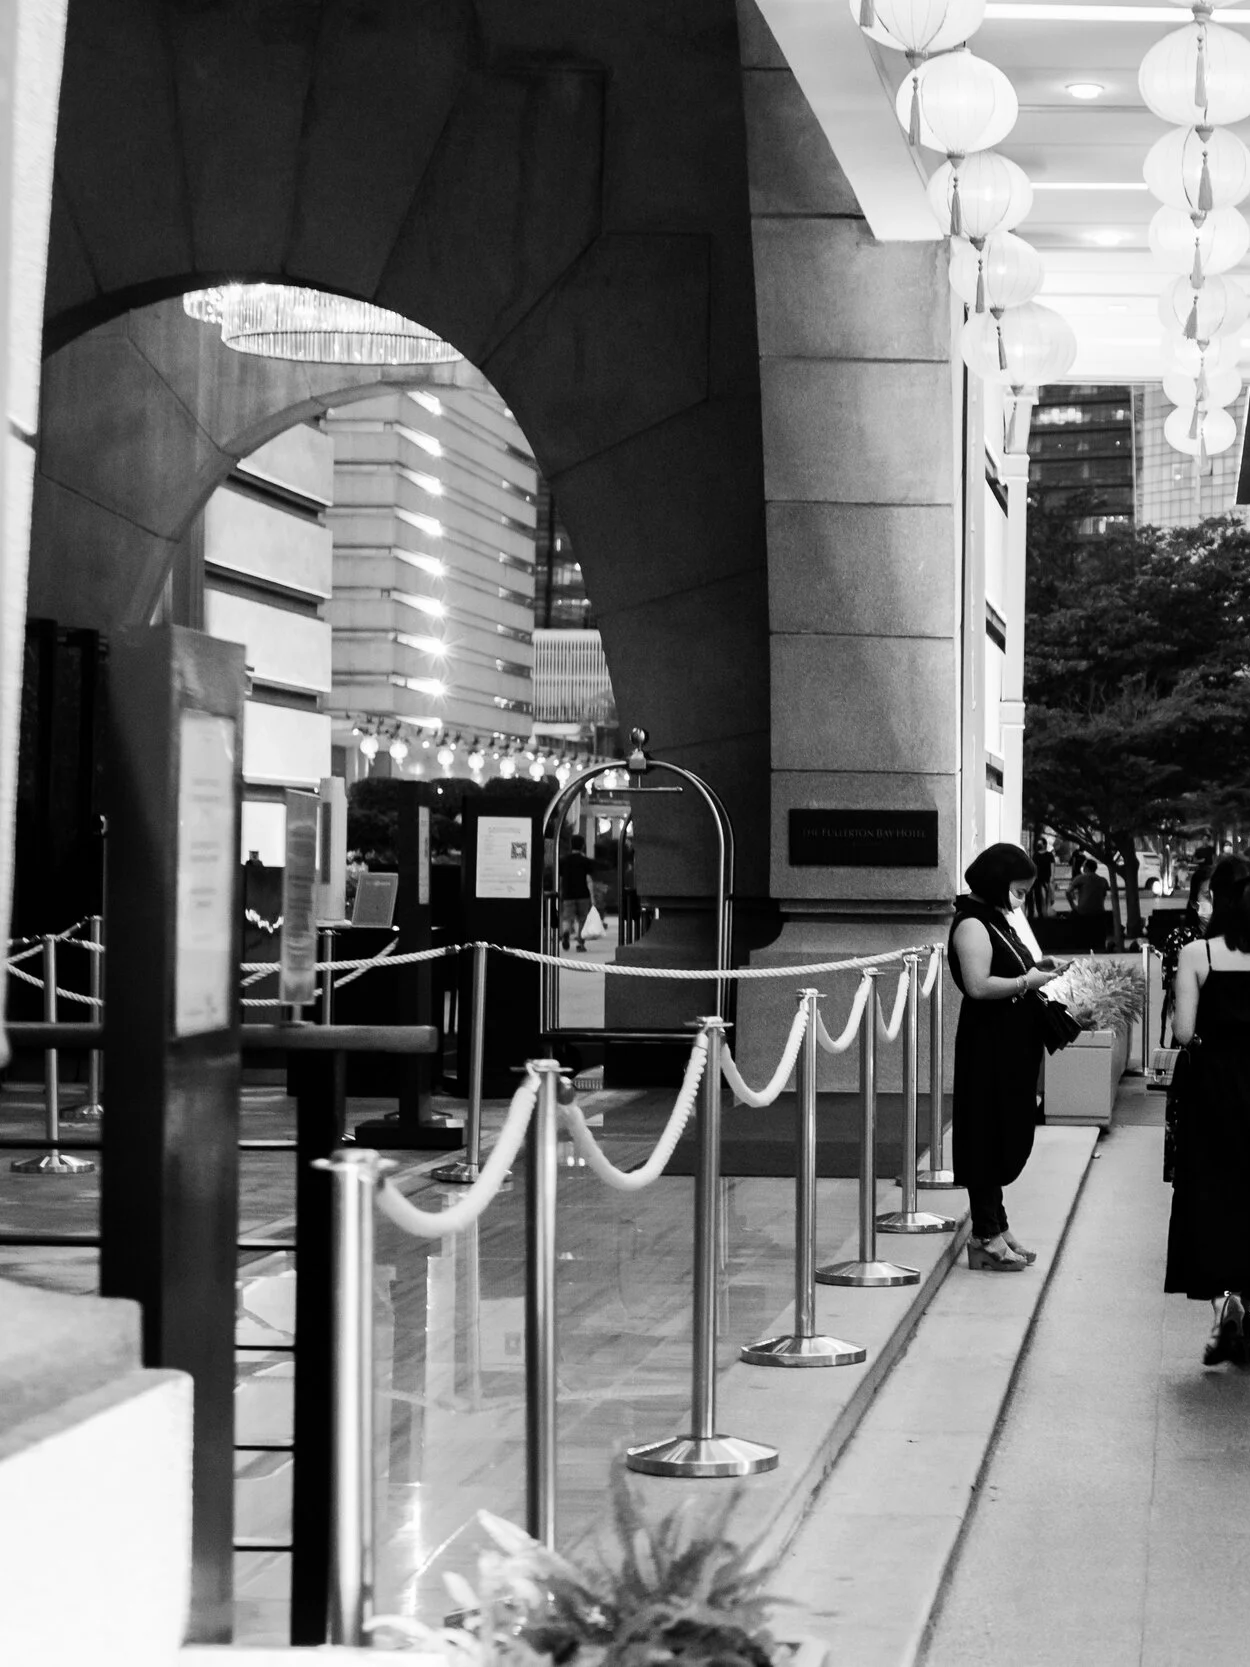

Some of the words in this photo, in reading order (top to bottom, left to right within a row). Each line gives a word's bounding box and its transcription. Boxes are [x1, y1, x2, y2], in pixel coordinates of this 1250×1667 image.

[802, 828, 817, 838] THE
[821, 828, 875, 838] FULLERTON
[876, 828, 894, 839] BAY
[895, 829, 926, 839] HOTEL
